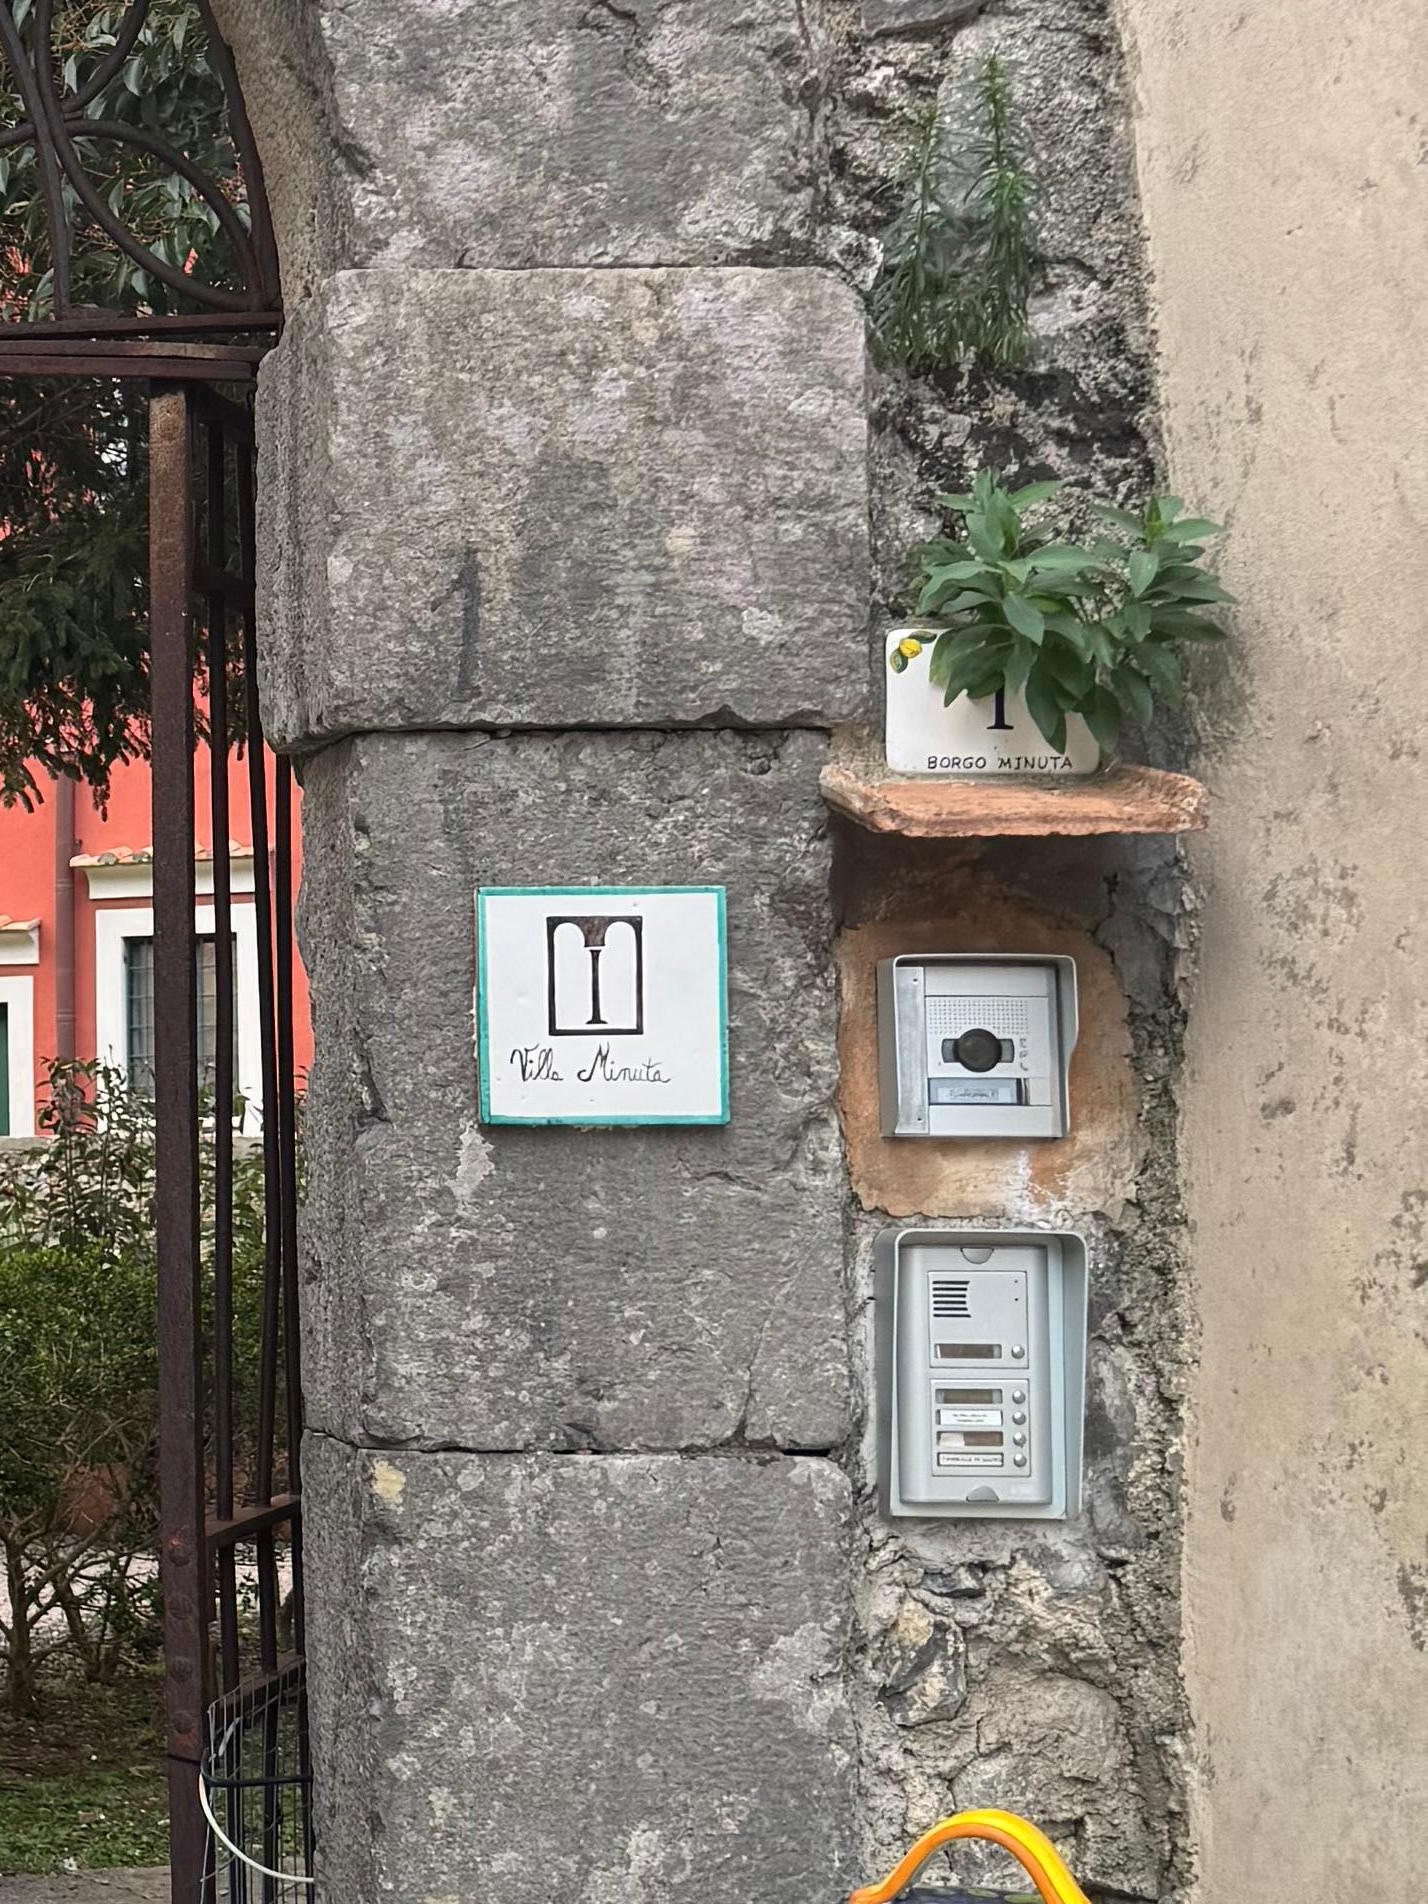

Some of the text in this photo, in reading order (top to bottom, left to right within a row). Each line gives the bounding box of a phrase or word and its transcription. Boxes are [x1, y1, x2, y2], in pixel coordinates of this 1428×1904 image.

[927, 755, 1073, 770] BORGO MINUTA
[510, 1041, 672, 1084] Villa Minuta
